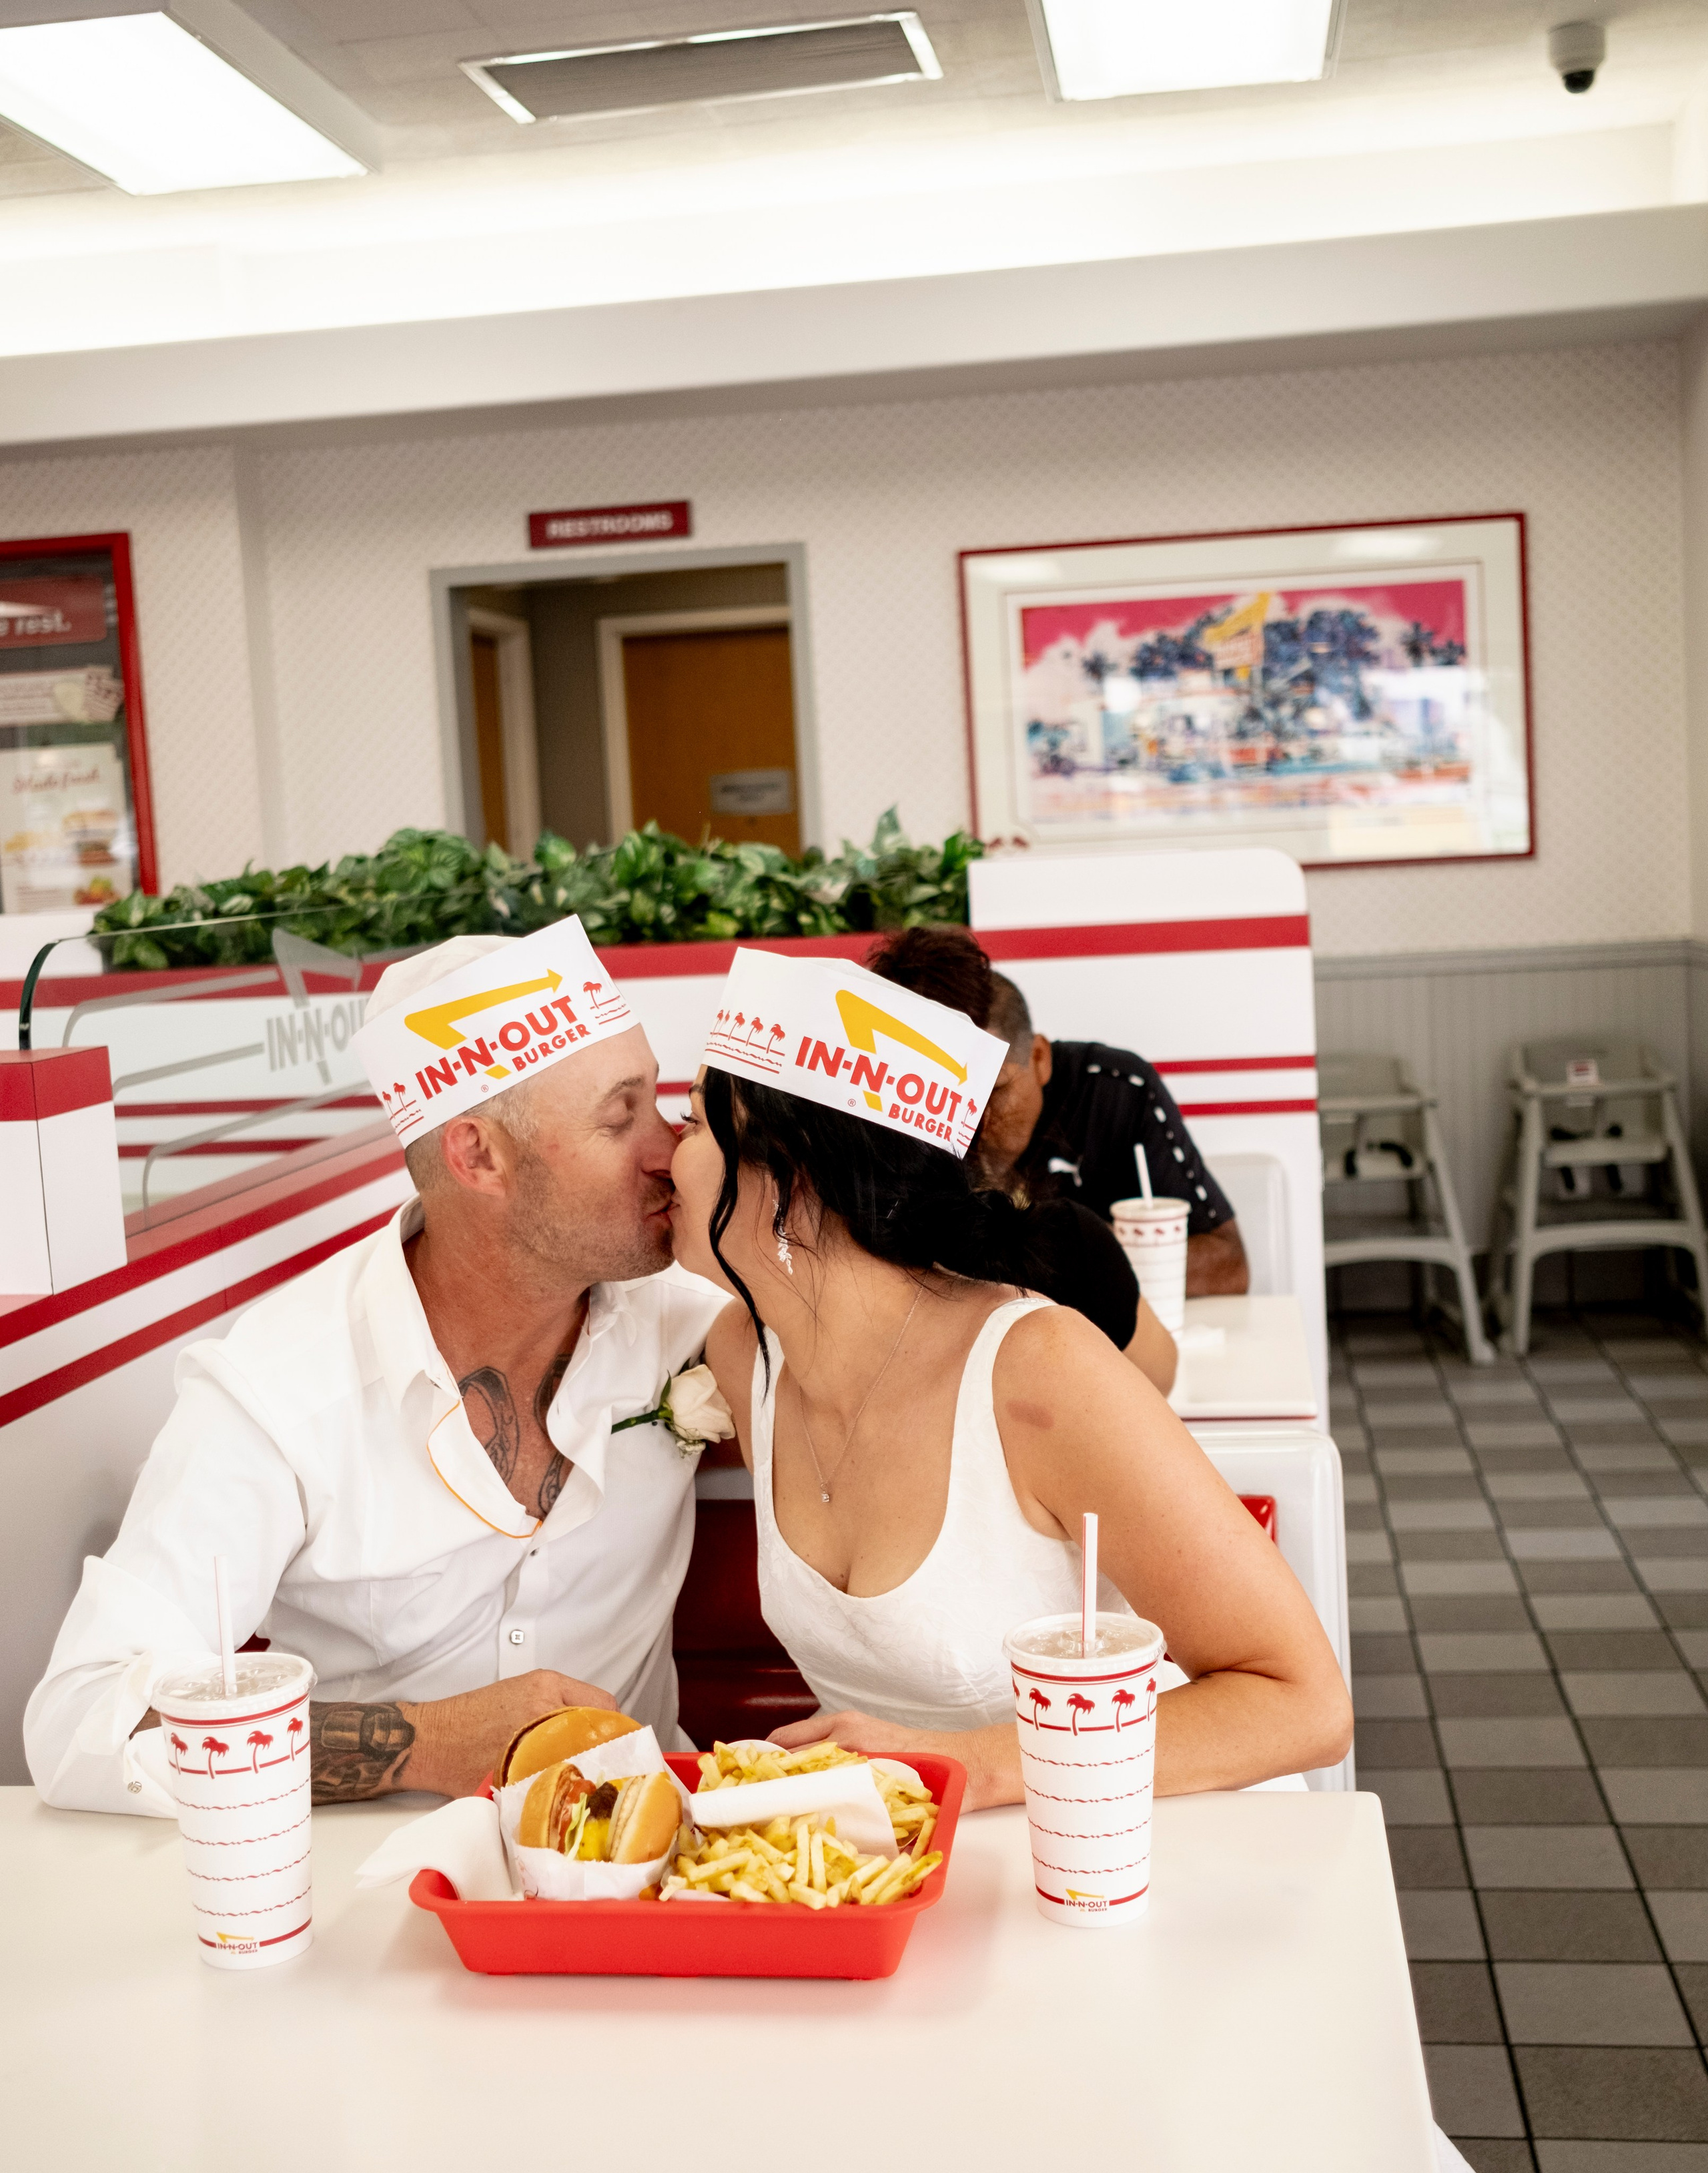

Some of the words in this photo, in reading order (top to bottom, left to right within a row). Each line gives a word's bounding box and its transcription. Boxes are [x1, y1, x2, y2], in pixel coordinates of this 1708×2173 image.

[546, 510, 673, 539] RESTROOMS
[266, 997, 370, 1072] IN-N-OU
[511, 1023, 592, 1072] BURGER
[888, 1103, 953, 1143] BURGER
